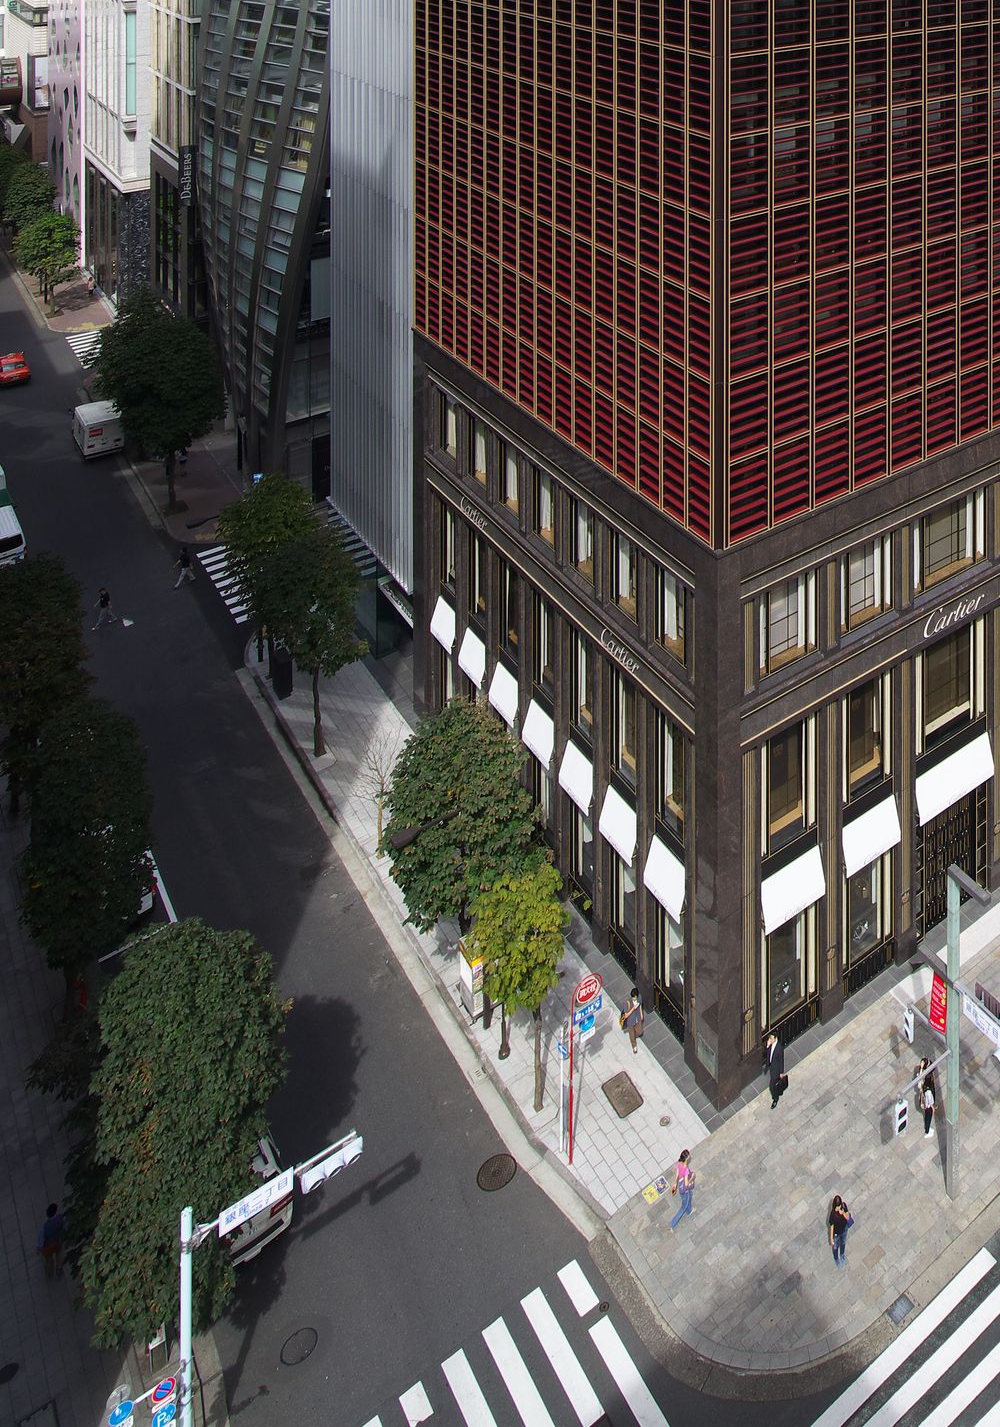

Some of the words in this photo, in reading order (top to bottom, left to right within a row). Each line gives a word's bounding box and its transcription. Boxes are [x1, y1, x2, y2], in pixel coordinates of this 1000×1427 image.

[460, 496, 488, 530] Cartier
[923, 594, 985, 639] Cartier
[600, 628, 640, 673] Cartier
[225, 1176, 288, 1225] 銀座二丁目
